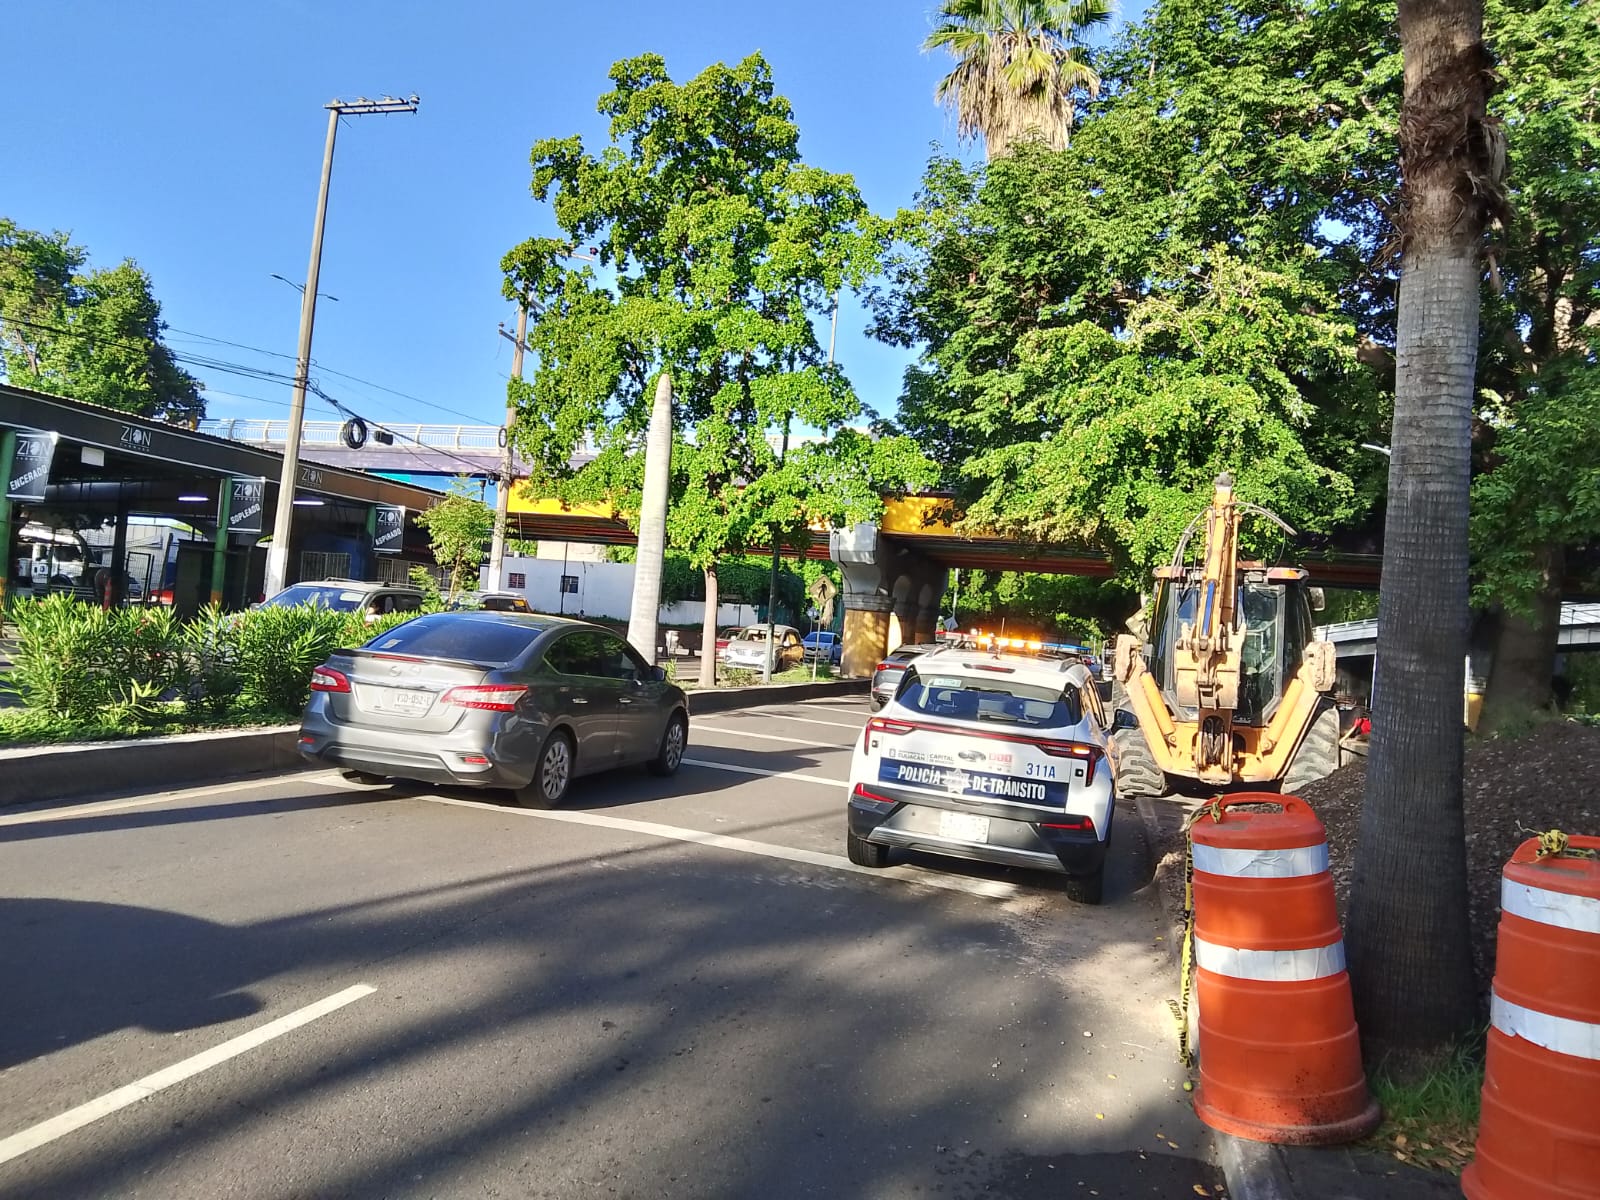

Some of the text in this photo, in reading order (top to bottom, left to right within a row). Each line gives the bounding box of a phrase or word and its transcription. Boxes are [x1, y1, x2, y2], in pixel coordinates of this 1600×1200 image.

[9, 464, 48, 491] ENCERADO
[230, 503, 261, 525] SOPLEADO
[375, 527, 402, 546] ASPIRADO
[1026, 763, 1056, 779] 311A
[897, 765, 1046, 800] POLICÍA DE TRÁNSITO
